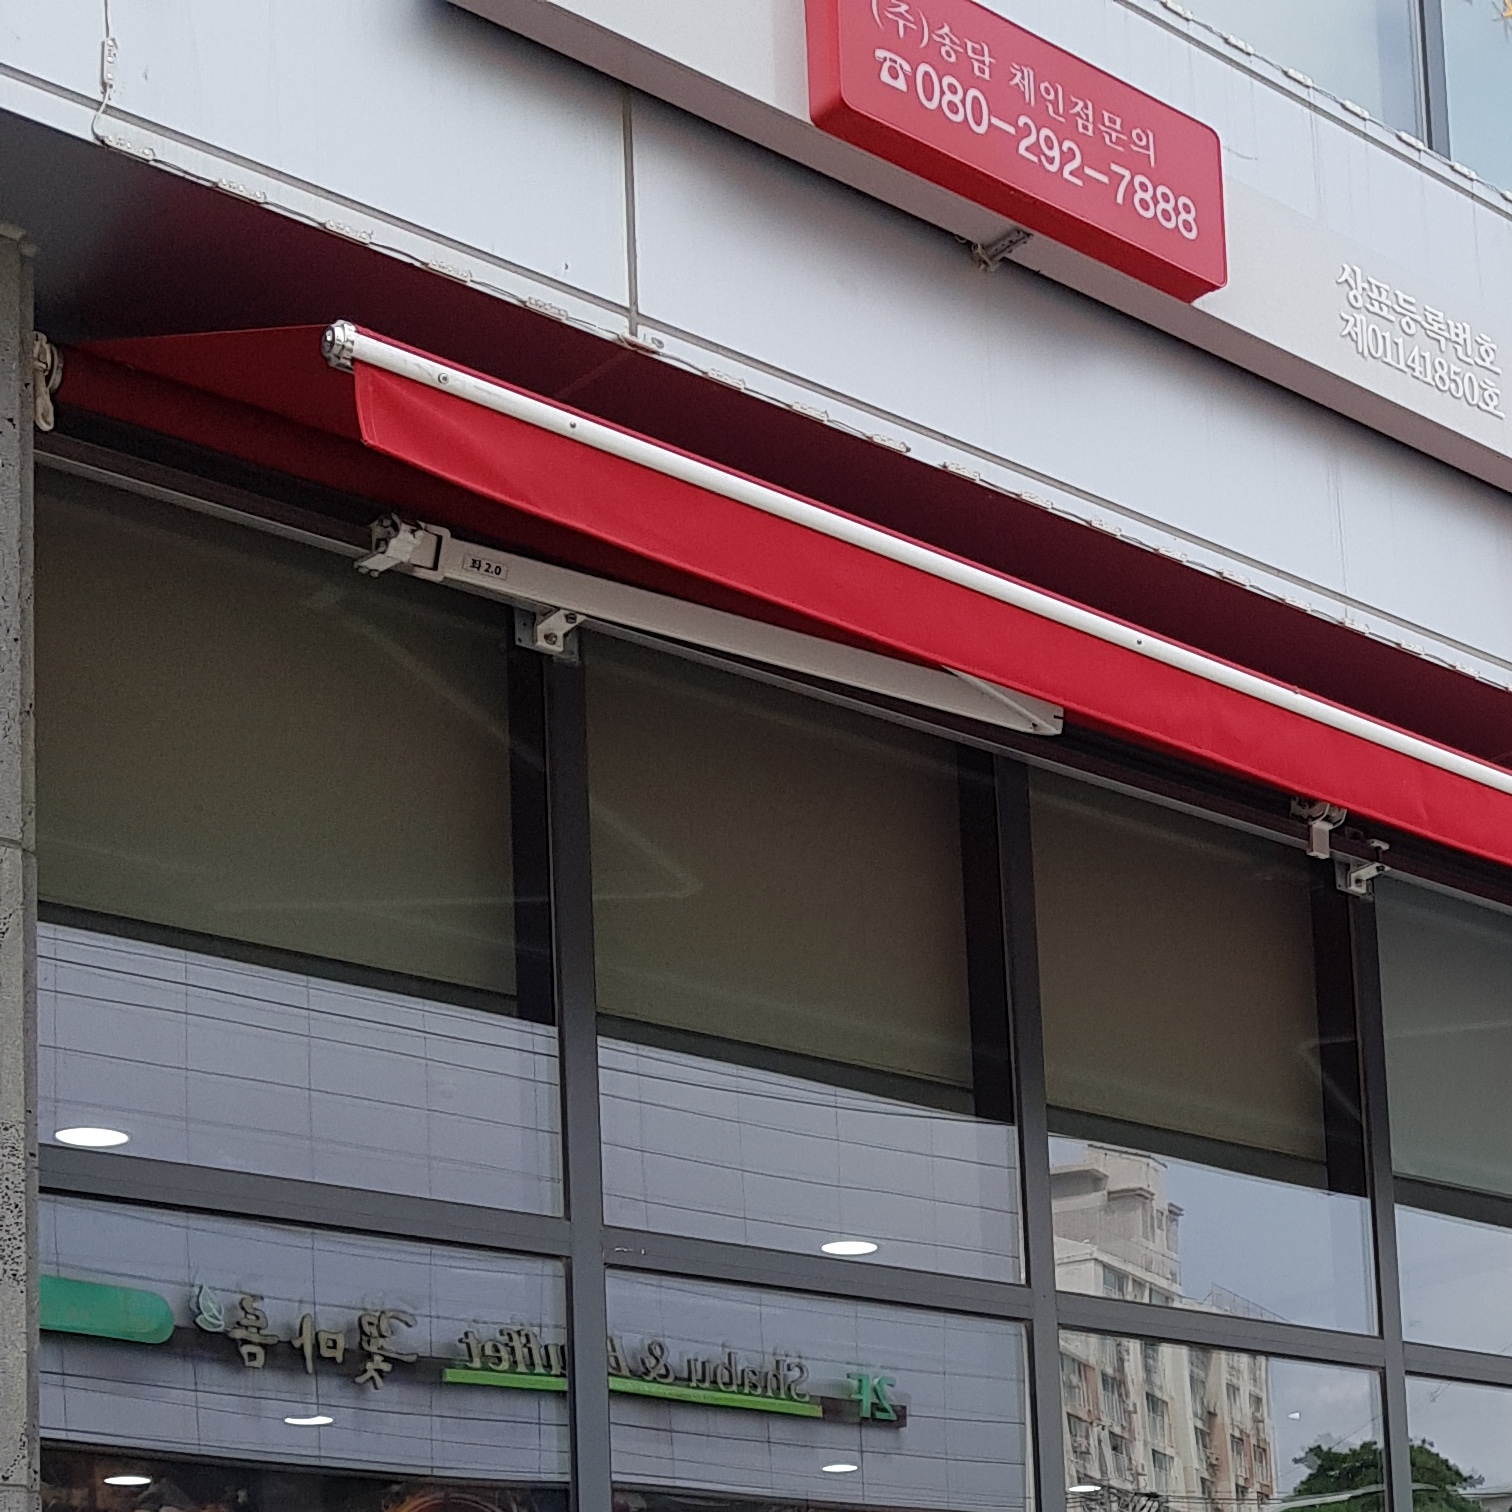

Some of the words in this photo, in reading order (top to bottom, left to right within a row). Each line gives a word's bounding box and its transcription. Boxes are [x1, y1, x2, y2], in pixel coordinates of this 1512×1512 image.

[915, 66, 1198, 241] 080-292-7888
[1009, 62, 1157, 168] 체인점문의
[1337, 263, 1500, 375] 상표등록번호
[1339, 311, 1504, 418] 제01141850호
